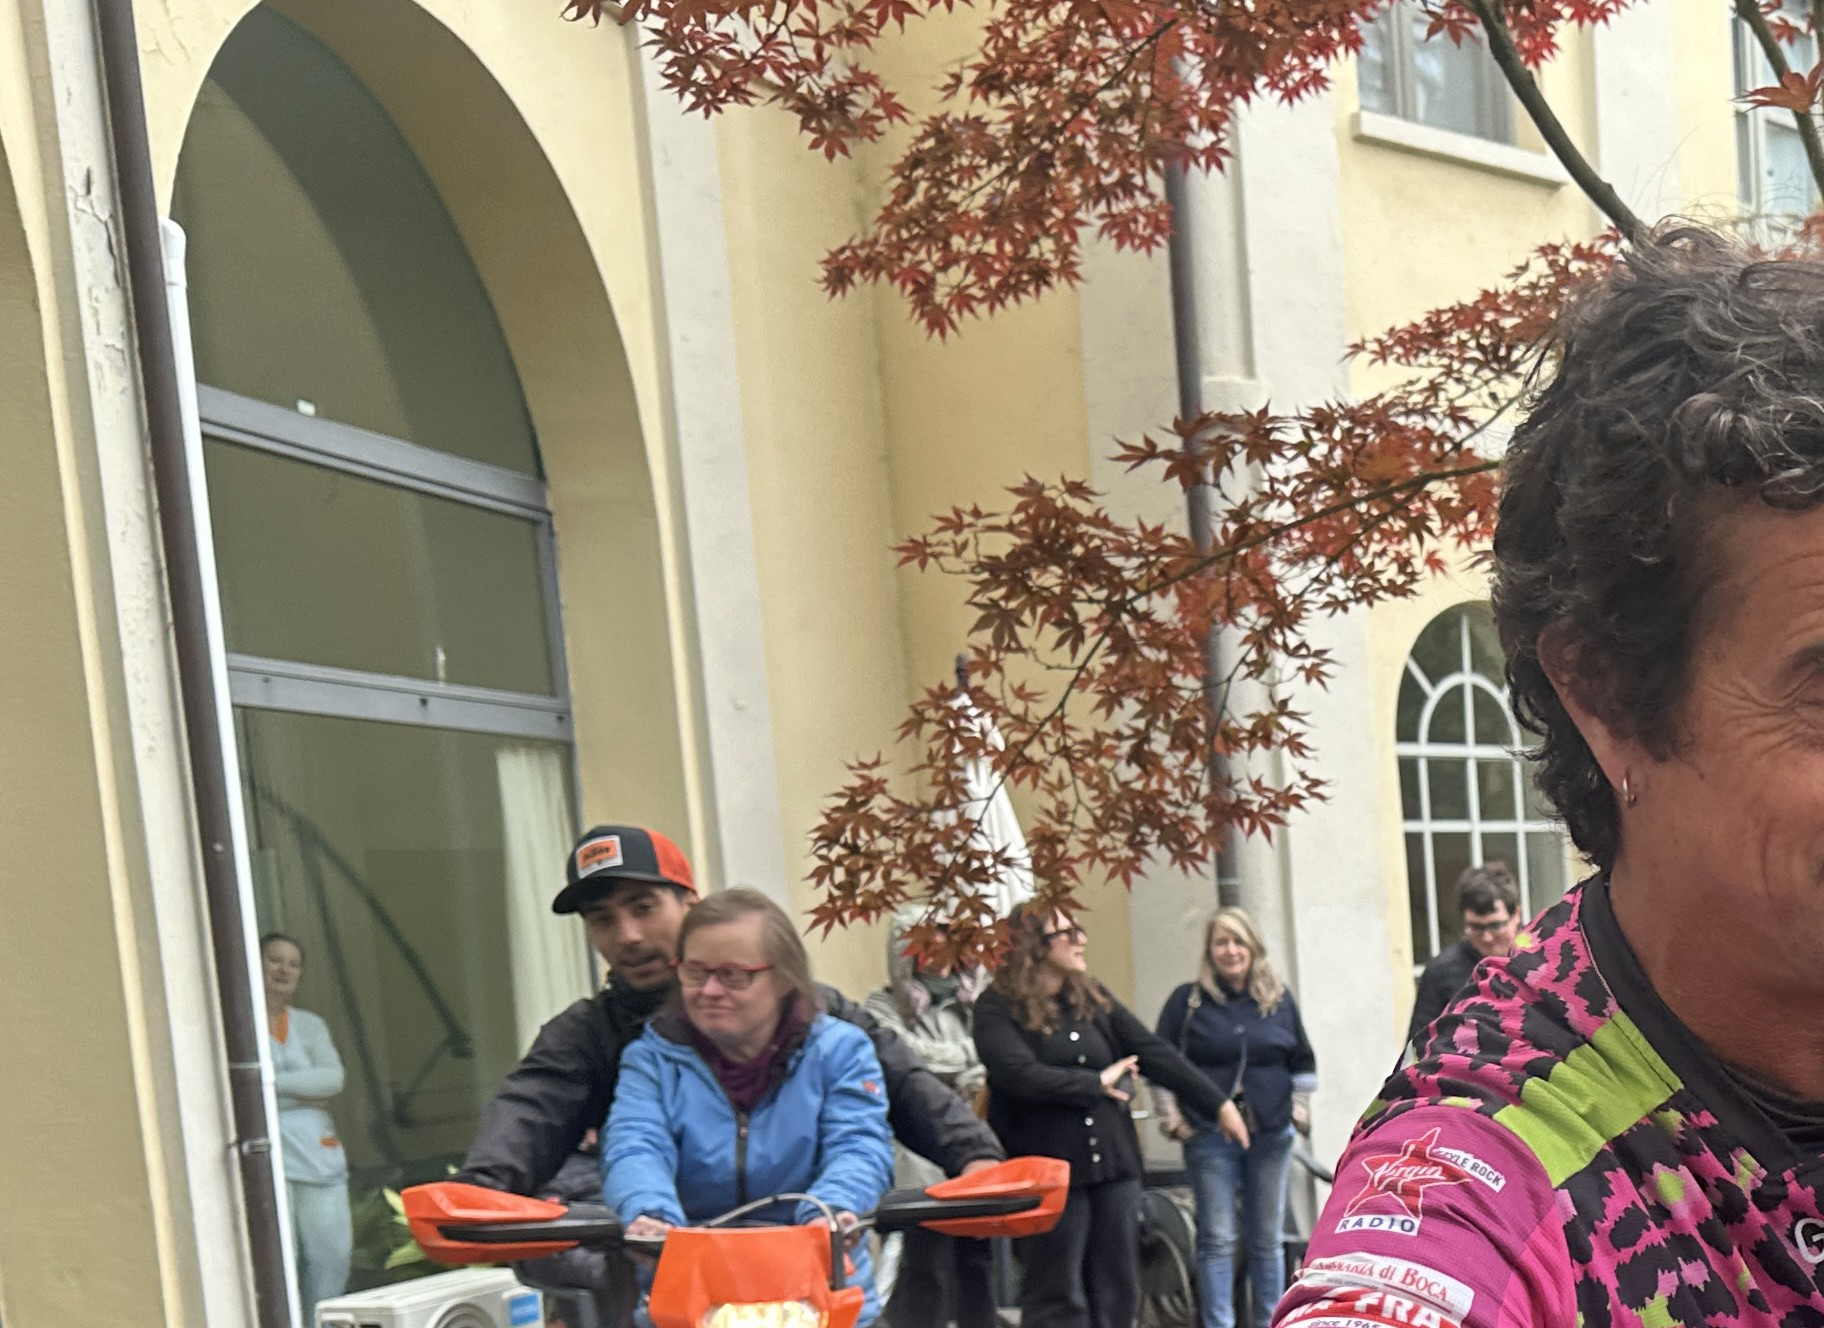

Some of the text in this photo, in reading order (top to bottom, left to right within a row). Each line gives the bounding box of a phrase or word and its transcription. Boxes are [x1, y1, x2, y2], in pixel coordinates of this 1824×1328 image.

[1373, 1144, 1447, 1193] Virgin
[1470, 1161, 1503, 1187] ROCK
[1338, 1216, 1416, 1233] RADIO
[1379, 1265, 1397, 1280] di
[1308, 1319, 1341, 1328] since
